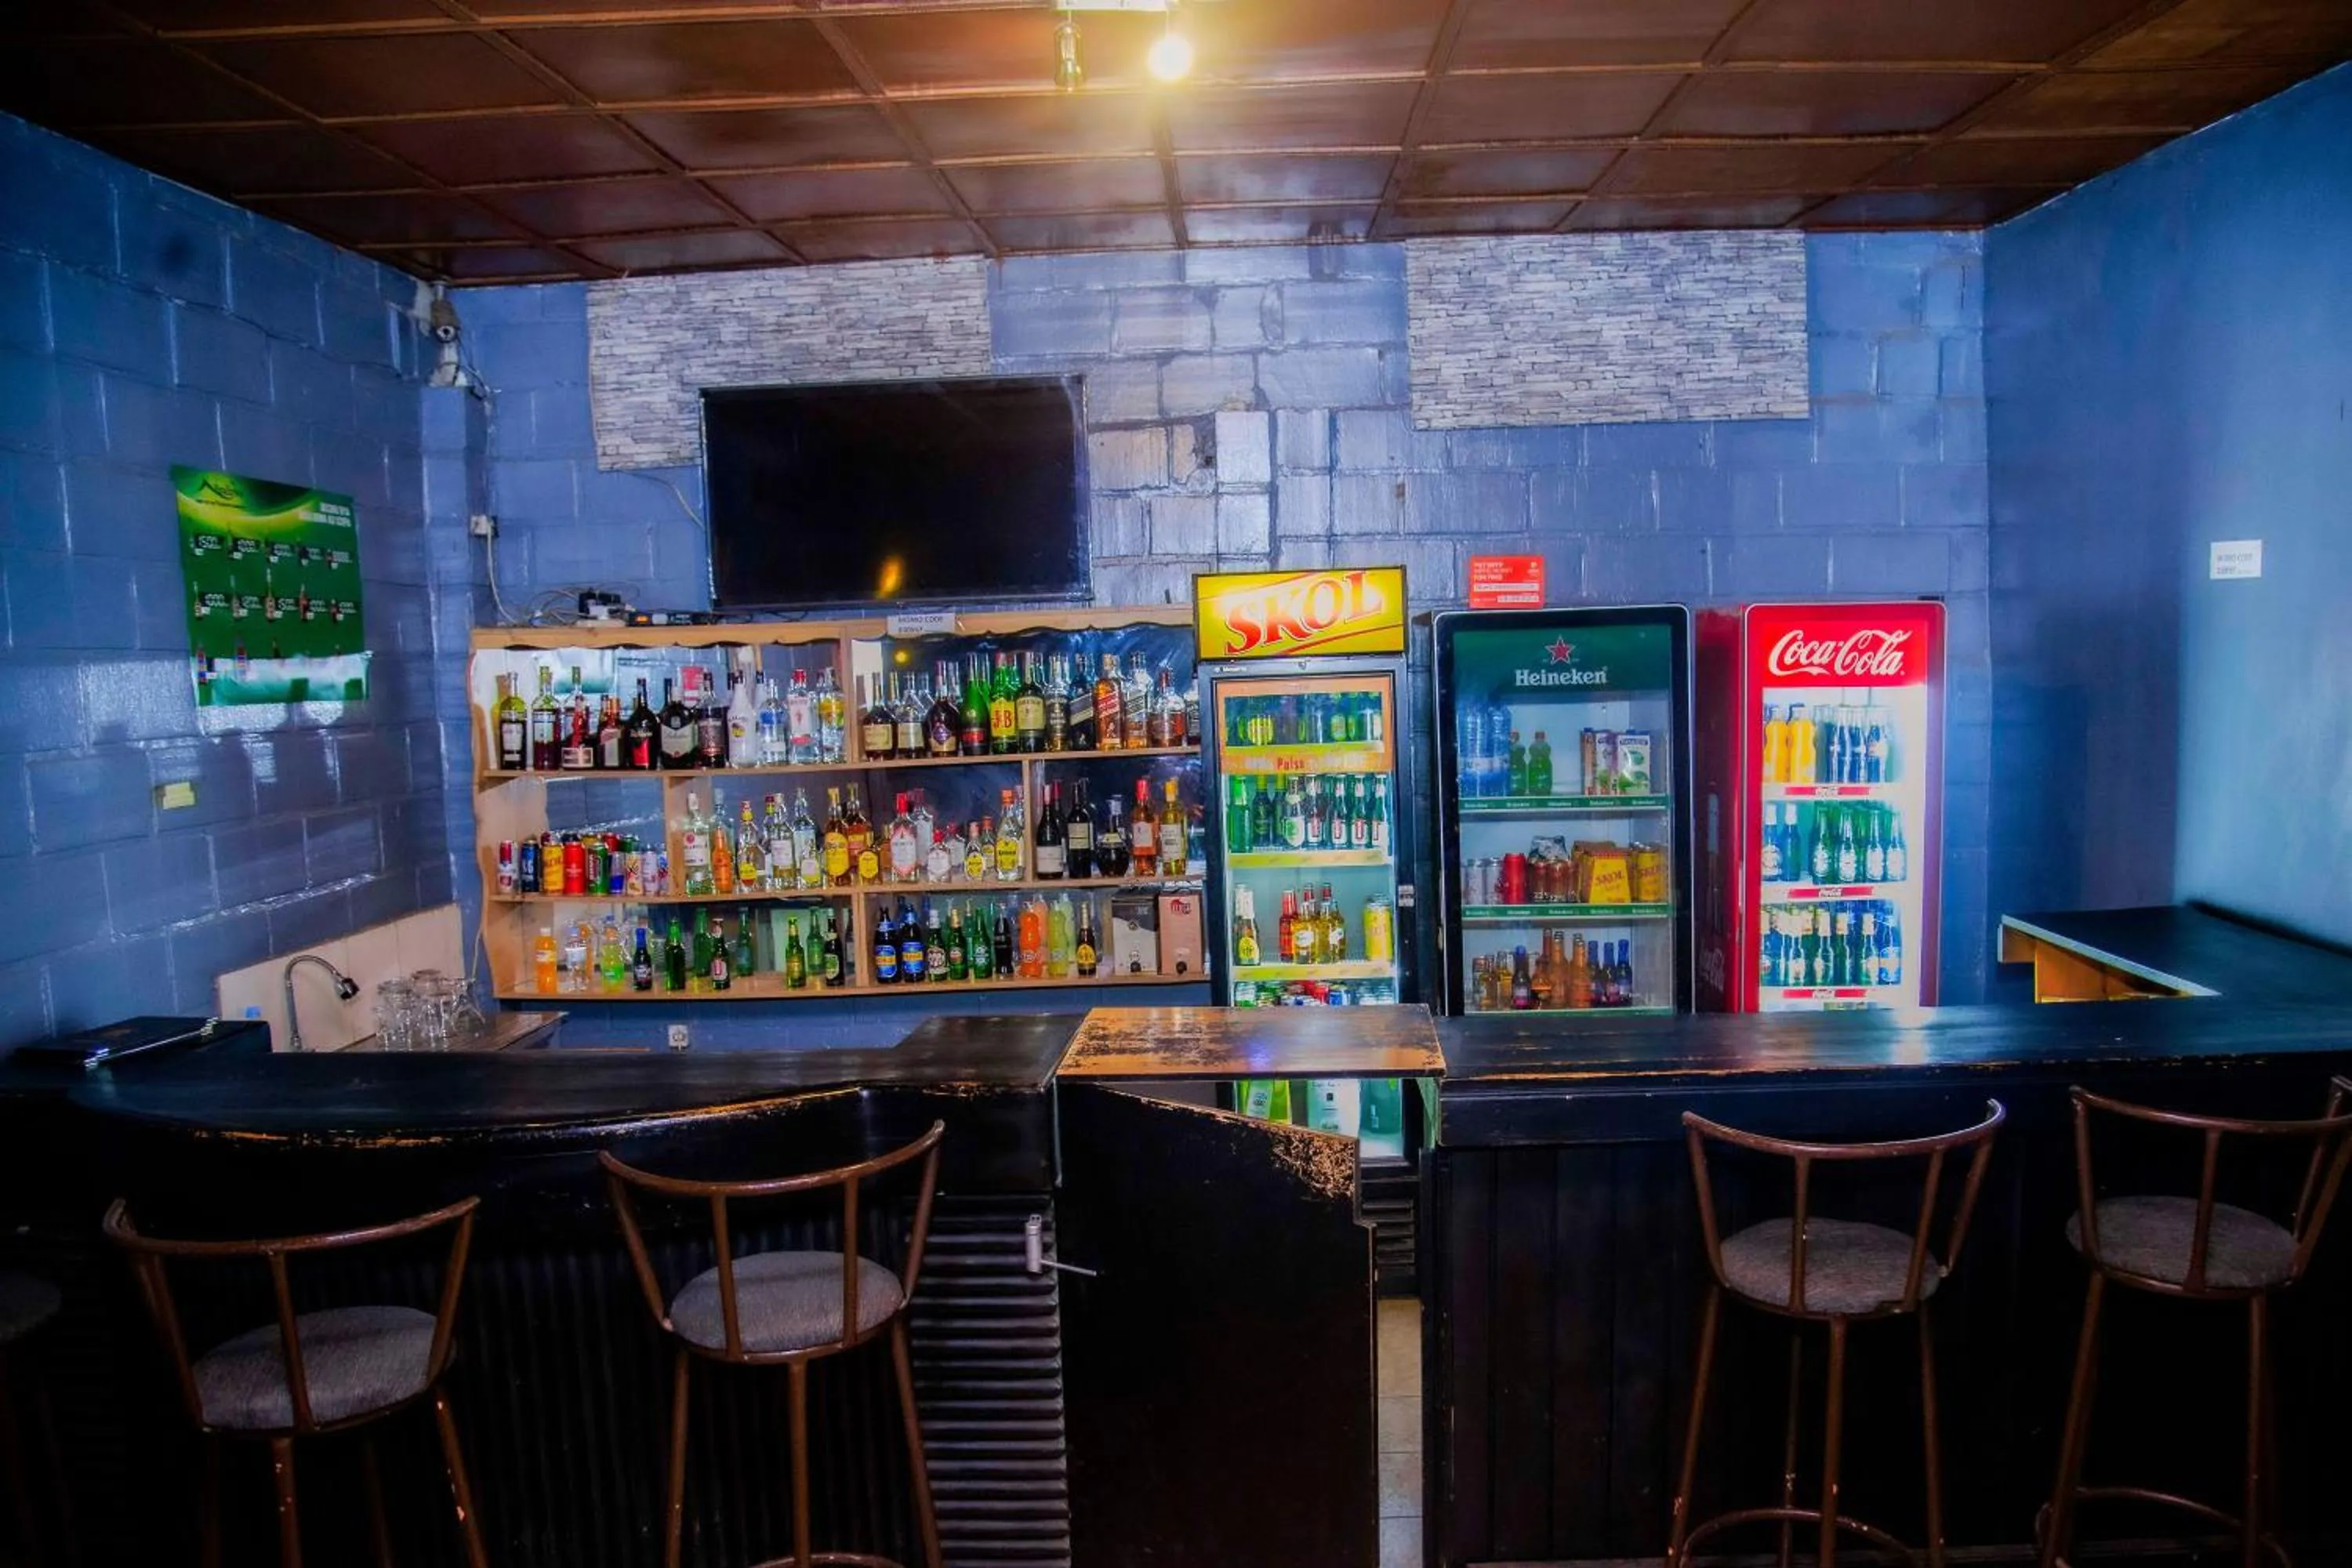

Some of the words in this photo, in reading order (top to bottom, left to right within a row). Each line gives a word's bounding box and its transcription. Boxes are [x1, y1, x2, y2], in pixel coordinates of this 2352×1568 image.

[1225, 572, 1382, 655] SKOL
[1768, 630, 1912, 676] Coca-Cola
[1515, 669, 1607, 686] Heineken
